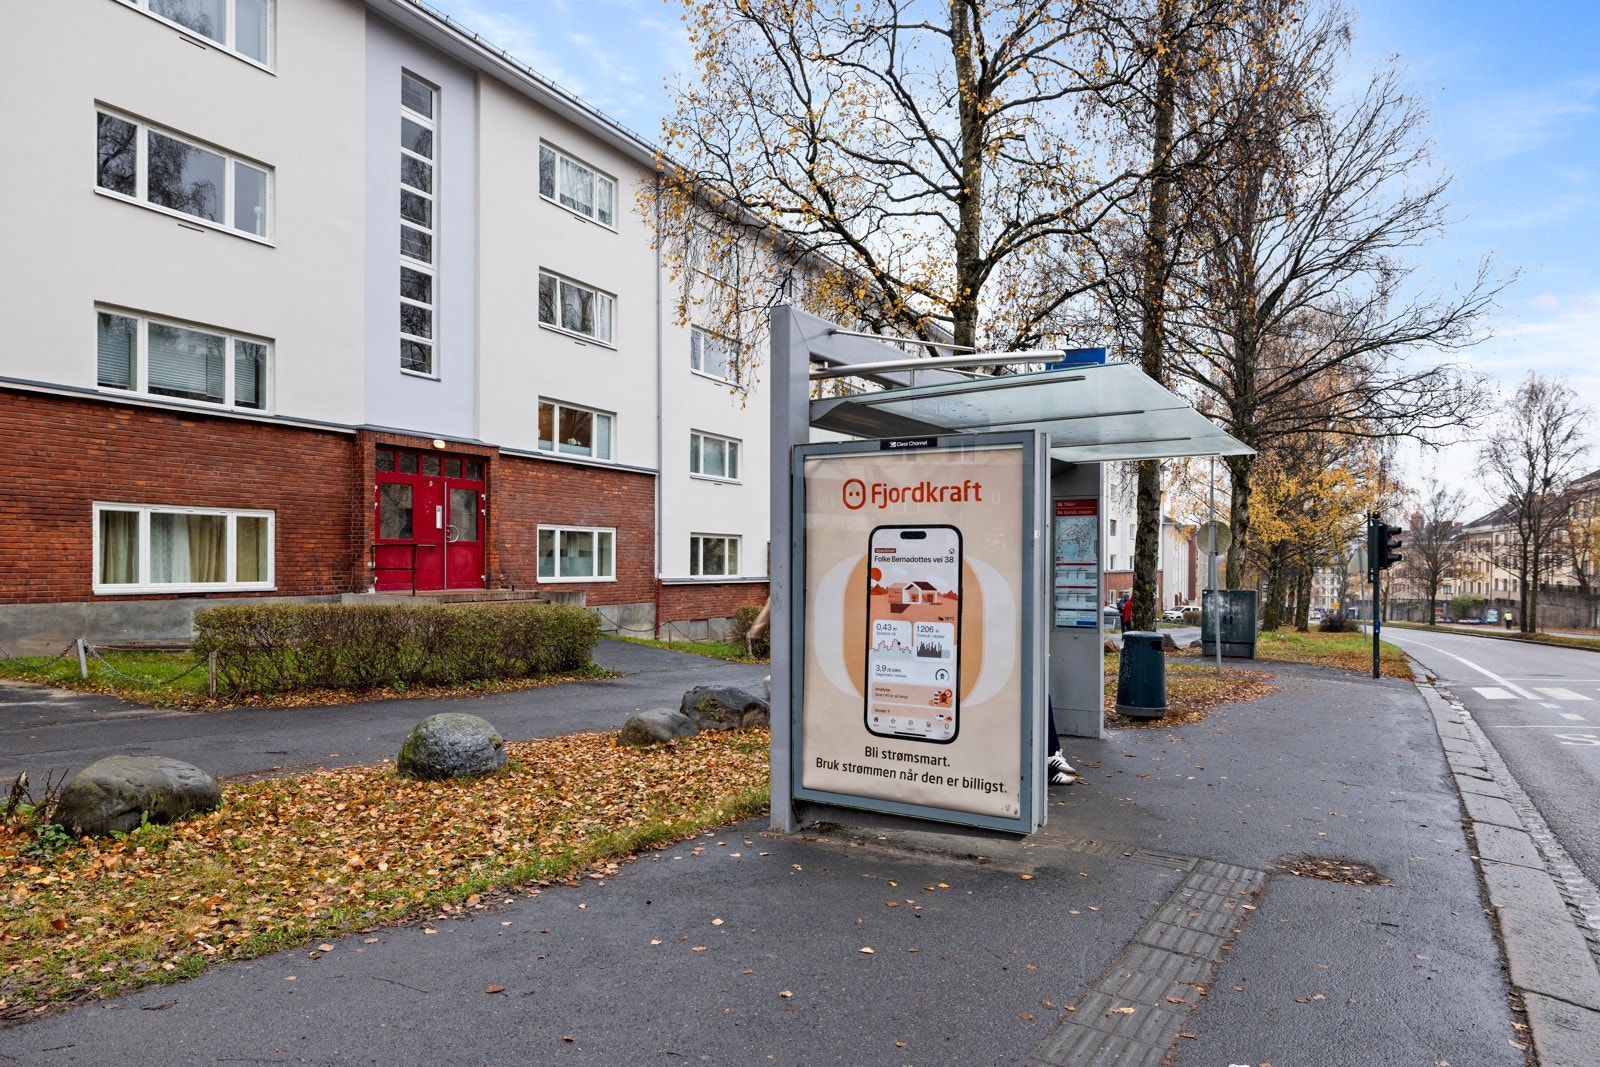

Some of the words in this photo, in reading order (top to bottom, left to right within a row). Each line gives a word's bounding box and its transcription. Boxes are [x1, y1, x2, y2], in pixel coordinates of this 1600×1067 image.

[871, 480, 982, 509] Fjordkraft
[875, 665, 886, 673] 3,9
[865, 746, 878, 759] Bli
[882, 749, 951, 767] strømsmart.
[816, 758, 839, 771] Bruk
[842, 763, 896, 779] strømmen
[900, 768, 918, 782] når
[921, 772, 943, 785] den
[946, 778, 959, 787] er
[962, 776, 1008, 794] billigst.
